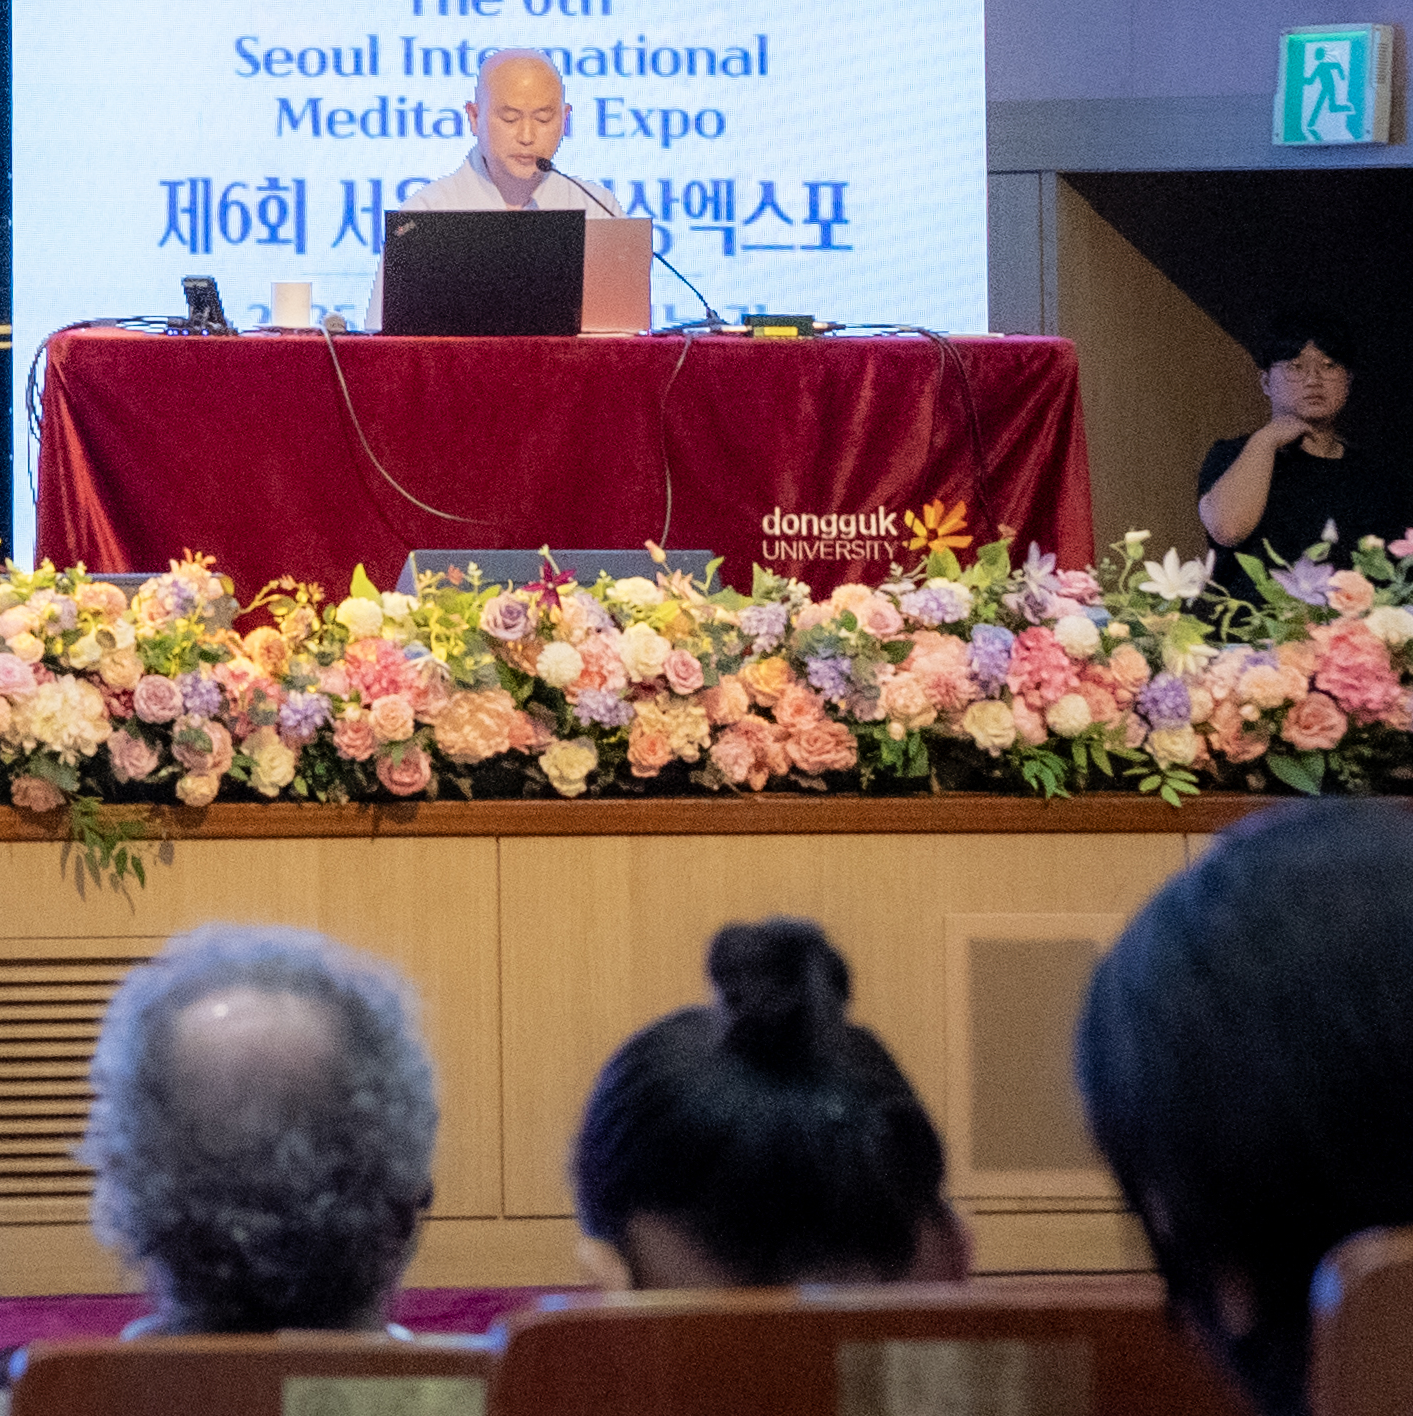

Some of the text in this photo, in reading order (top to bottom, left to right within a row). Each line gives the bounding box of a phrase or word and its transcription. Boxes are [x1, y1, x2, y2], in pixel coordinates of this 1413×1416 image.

[234, 33, 768, 78] Seoul Intnational
[275, 95, 727, 150] Medita Expo
[157, 176, 307, 255] 제6회
[761, 505, 898, 540] dongguk
[761, 539, 896, 561] UNIVERSITY
